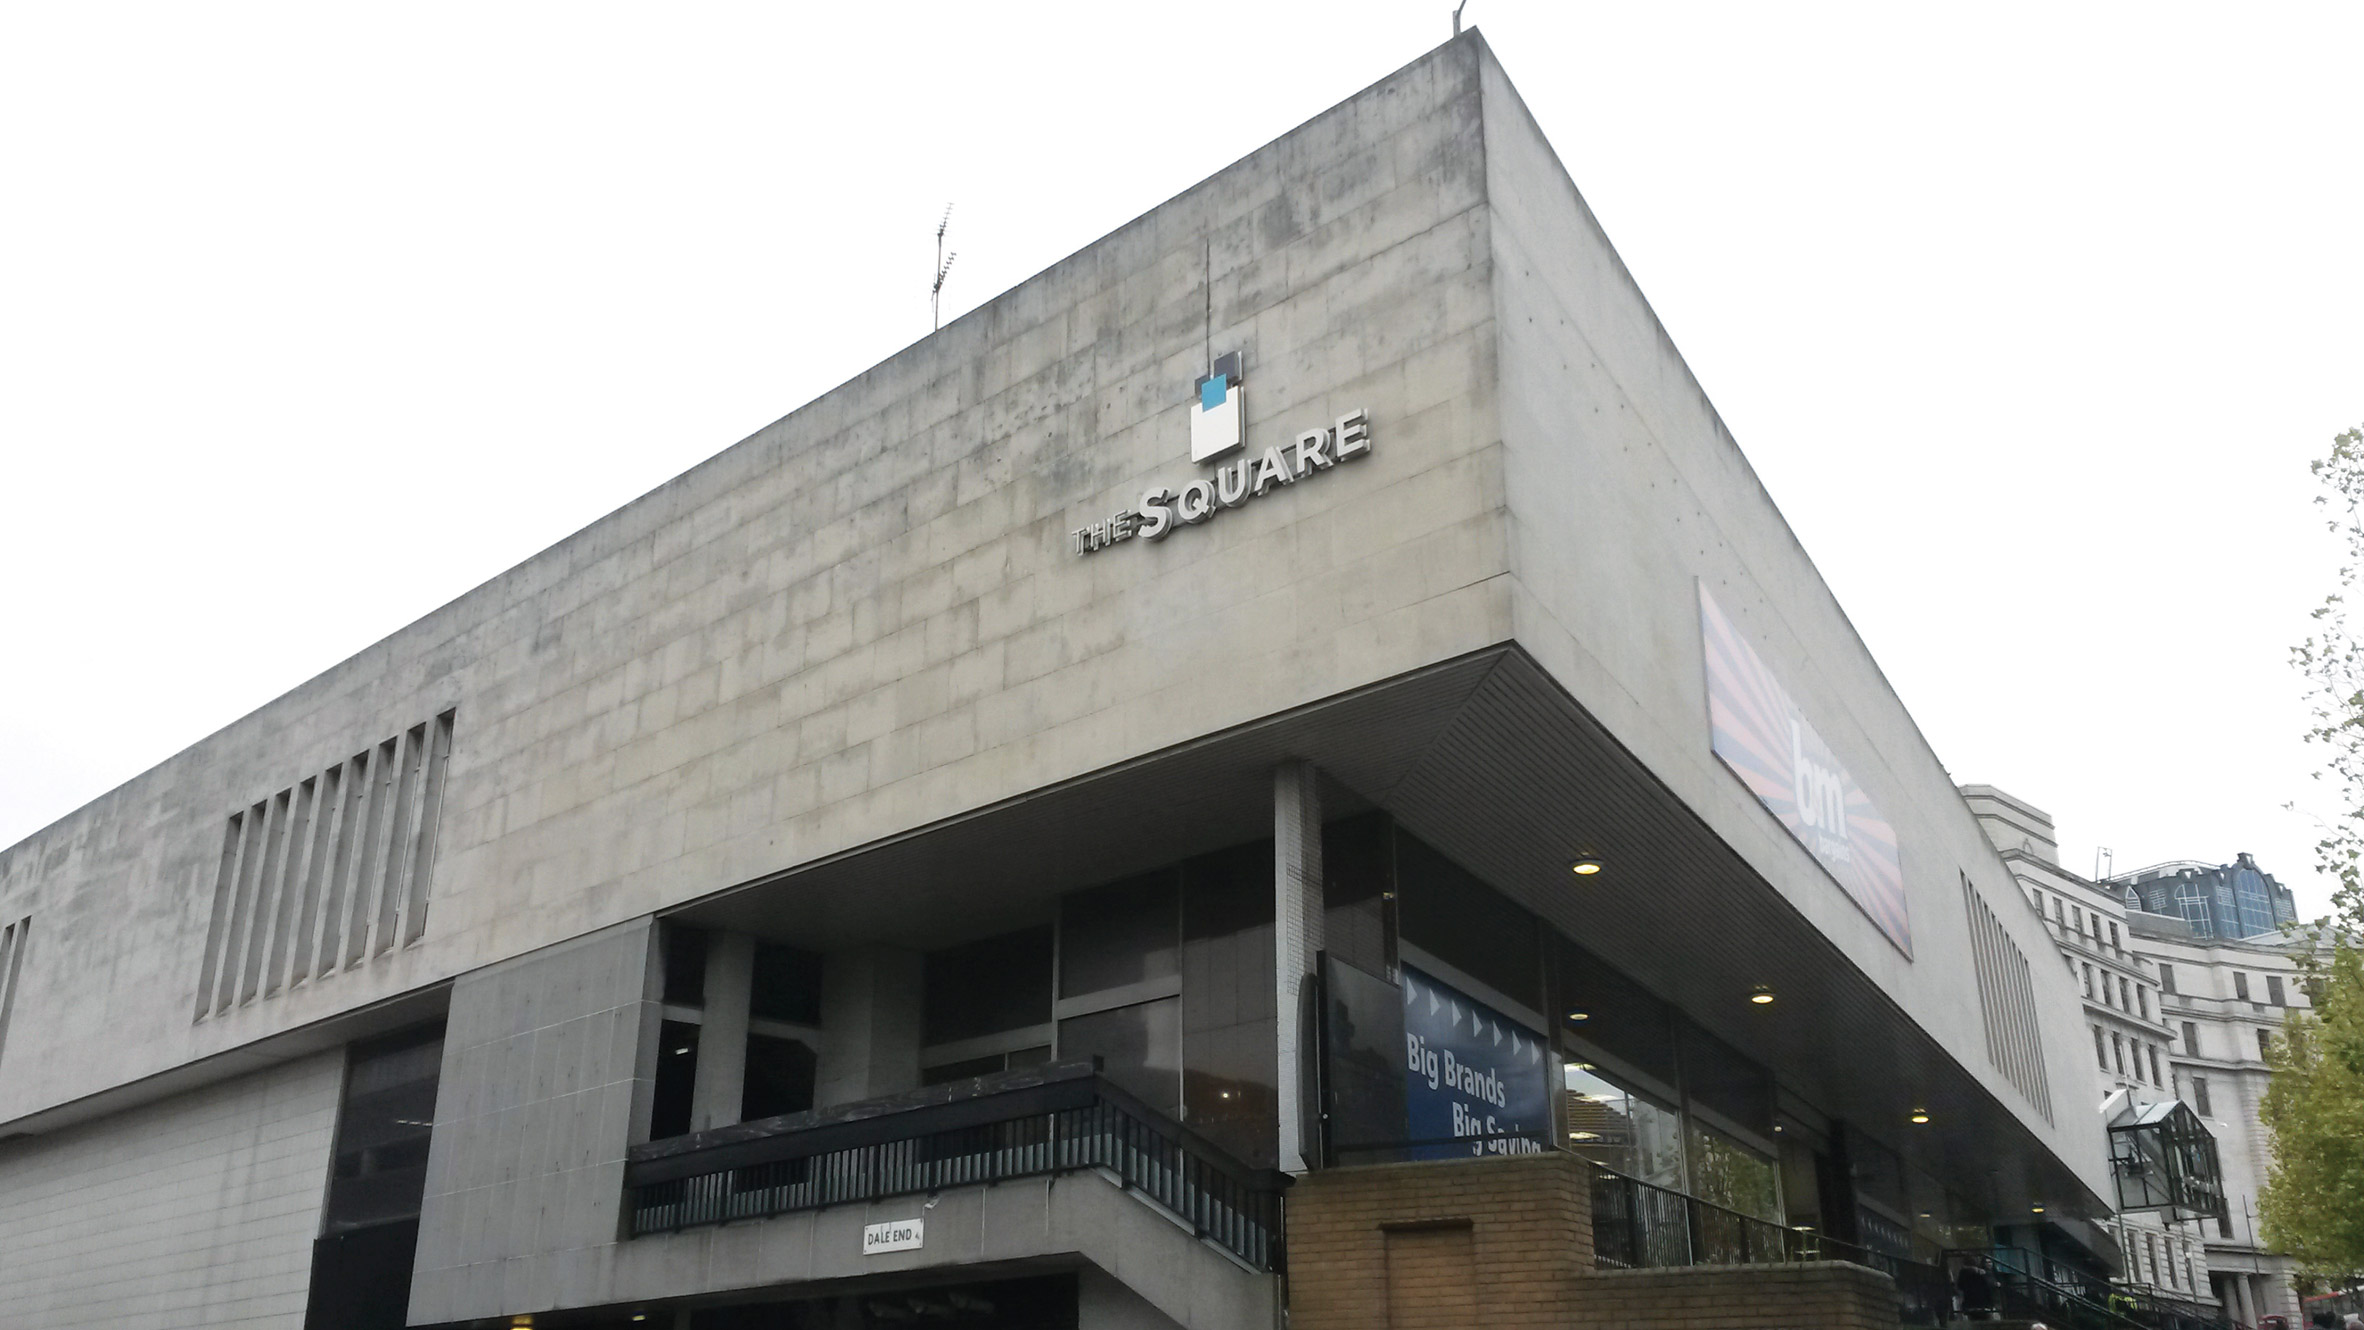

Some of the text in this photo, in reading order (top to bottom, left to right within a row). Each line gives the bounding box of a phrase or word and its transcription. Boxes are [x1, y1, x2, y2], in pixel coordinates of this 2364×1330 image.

[1071, 408, 1370, 556] THE SQUARE
[1791, 718, 1848, 840] bm
[1407, 1032, 1506, 1109] Big Brands
[868, 1231, 890, 1245] DALE
[893, 1228, 912, 1243] END
